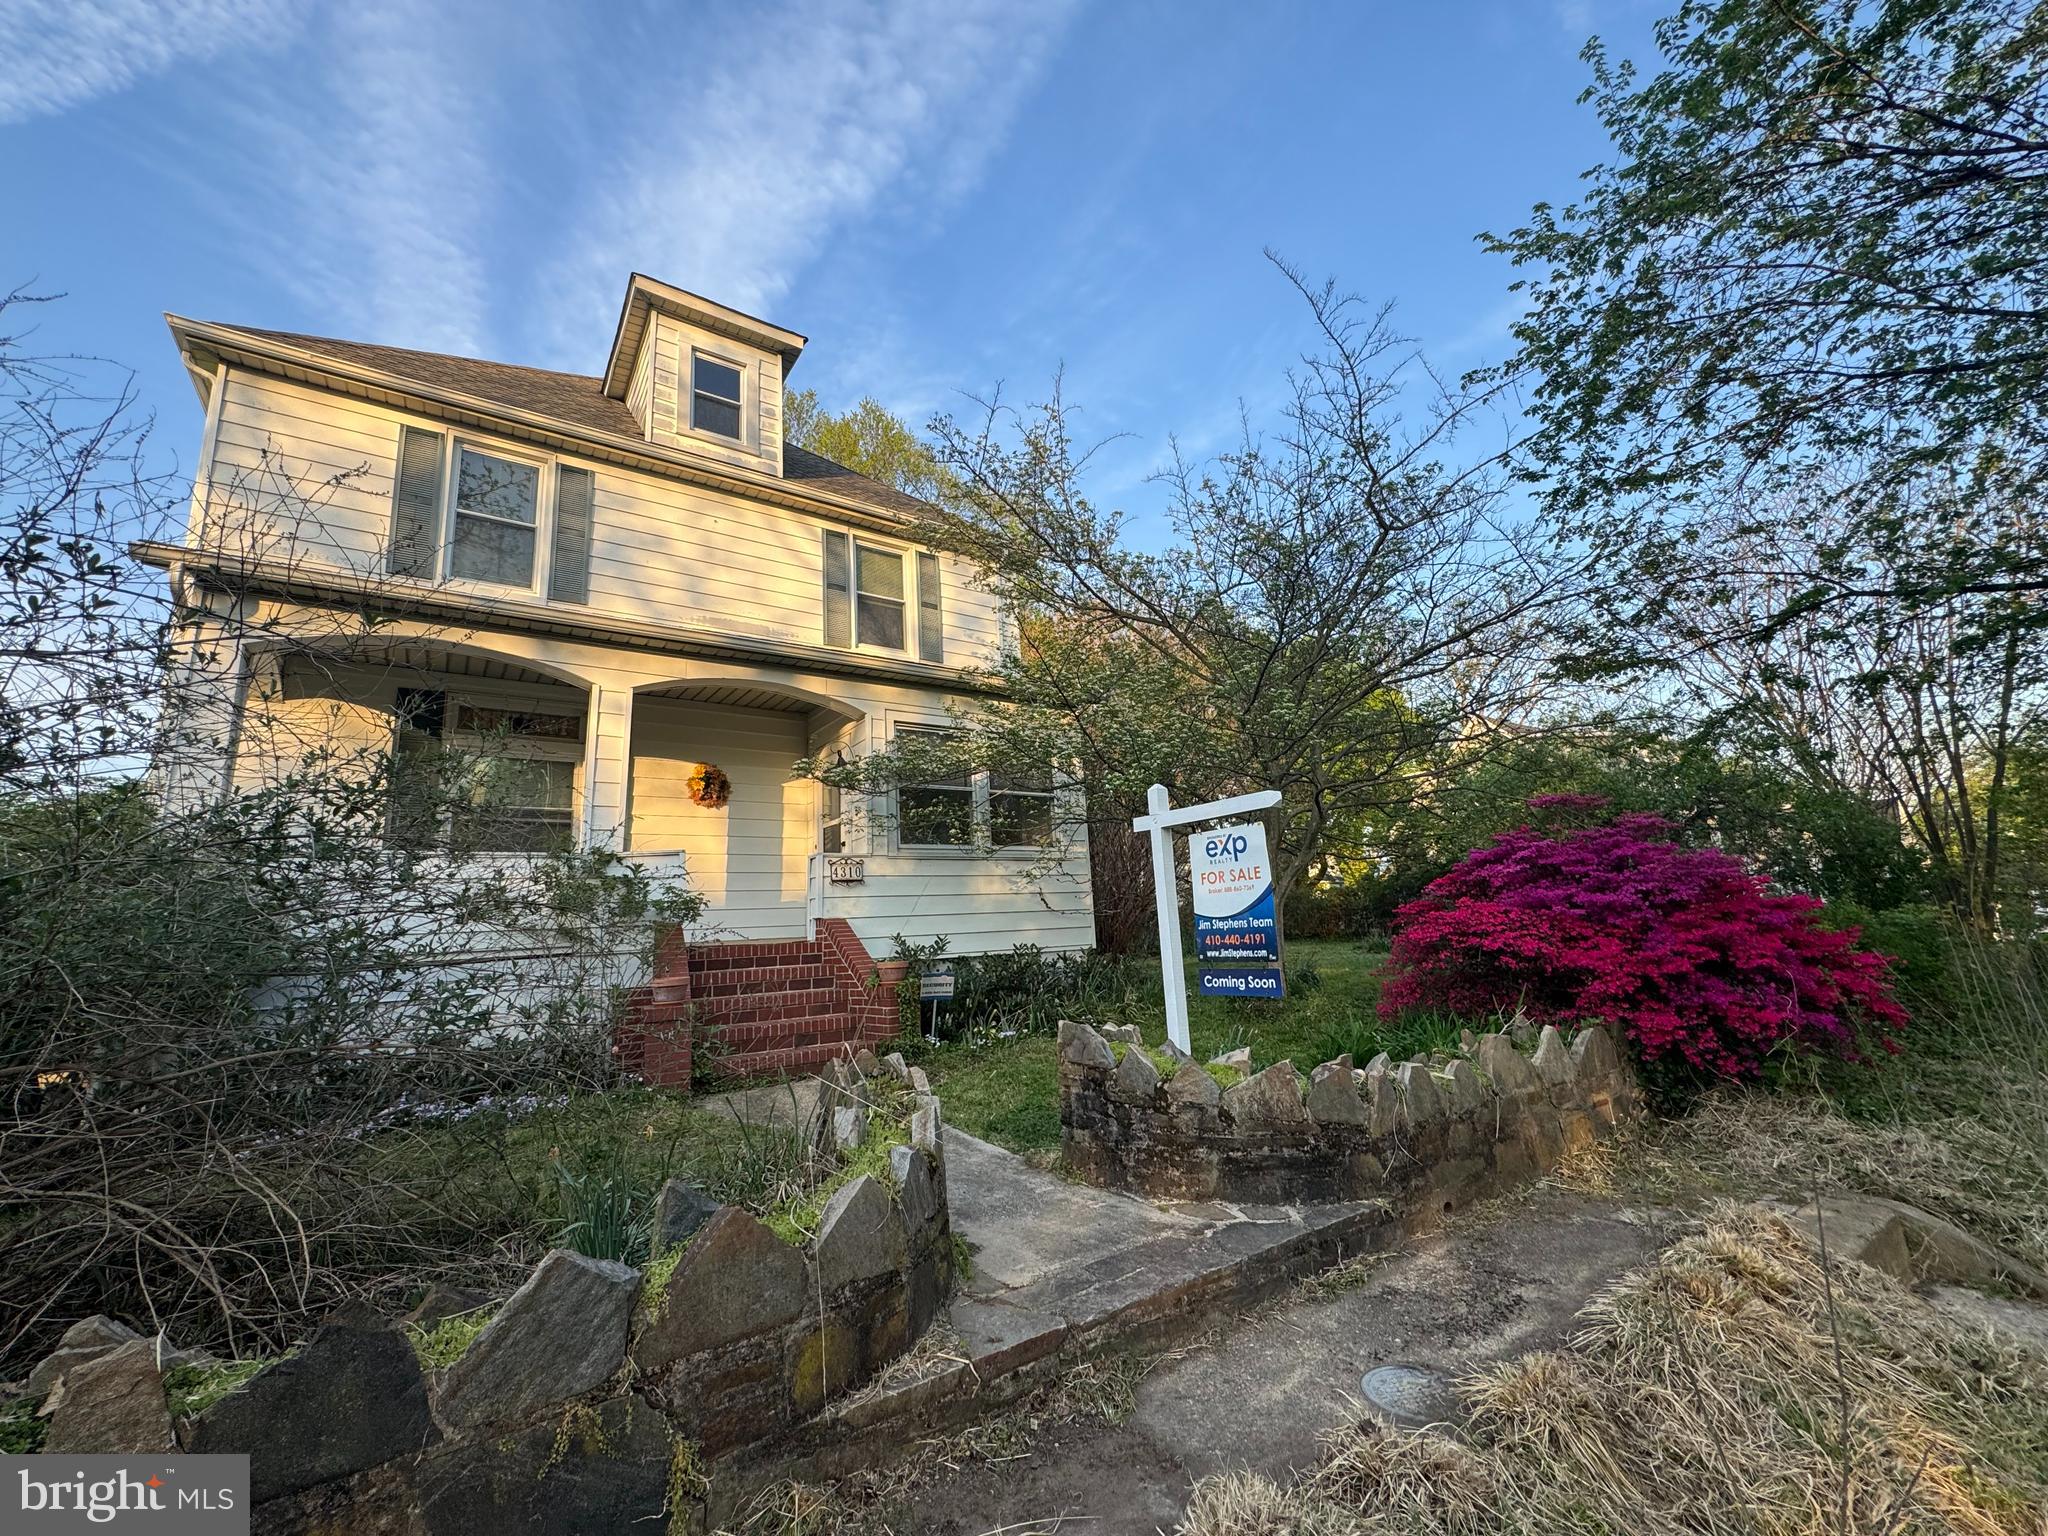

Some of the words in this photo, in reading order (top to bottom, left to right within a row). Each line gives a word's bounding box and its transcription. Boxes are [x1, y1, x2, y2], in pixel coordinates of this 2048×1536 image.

[1209, 857, 1233, 865] REALTY
[832, 866, 861, 878] 4310
[1200, 870, 1226, 885] FOR
[1229, 865, 1262, 882] SALE
[1198, 920, 1211, 930] Jim
[1212, 918, 1248, 931] Stephens
[1248, 917, 1273, 928] Team
[1205, 933, 1266, 945] 410-440-4191
[1206, 948, 1268, 959] www.JimStephens.com
[1204, 975, 1246, 990] Coming
[1247, 976, 1277, 989] Soon
